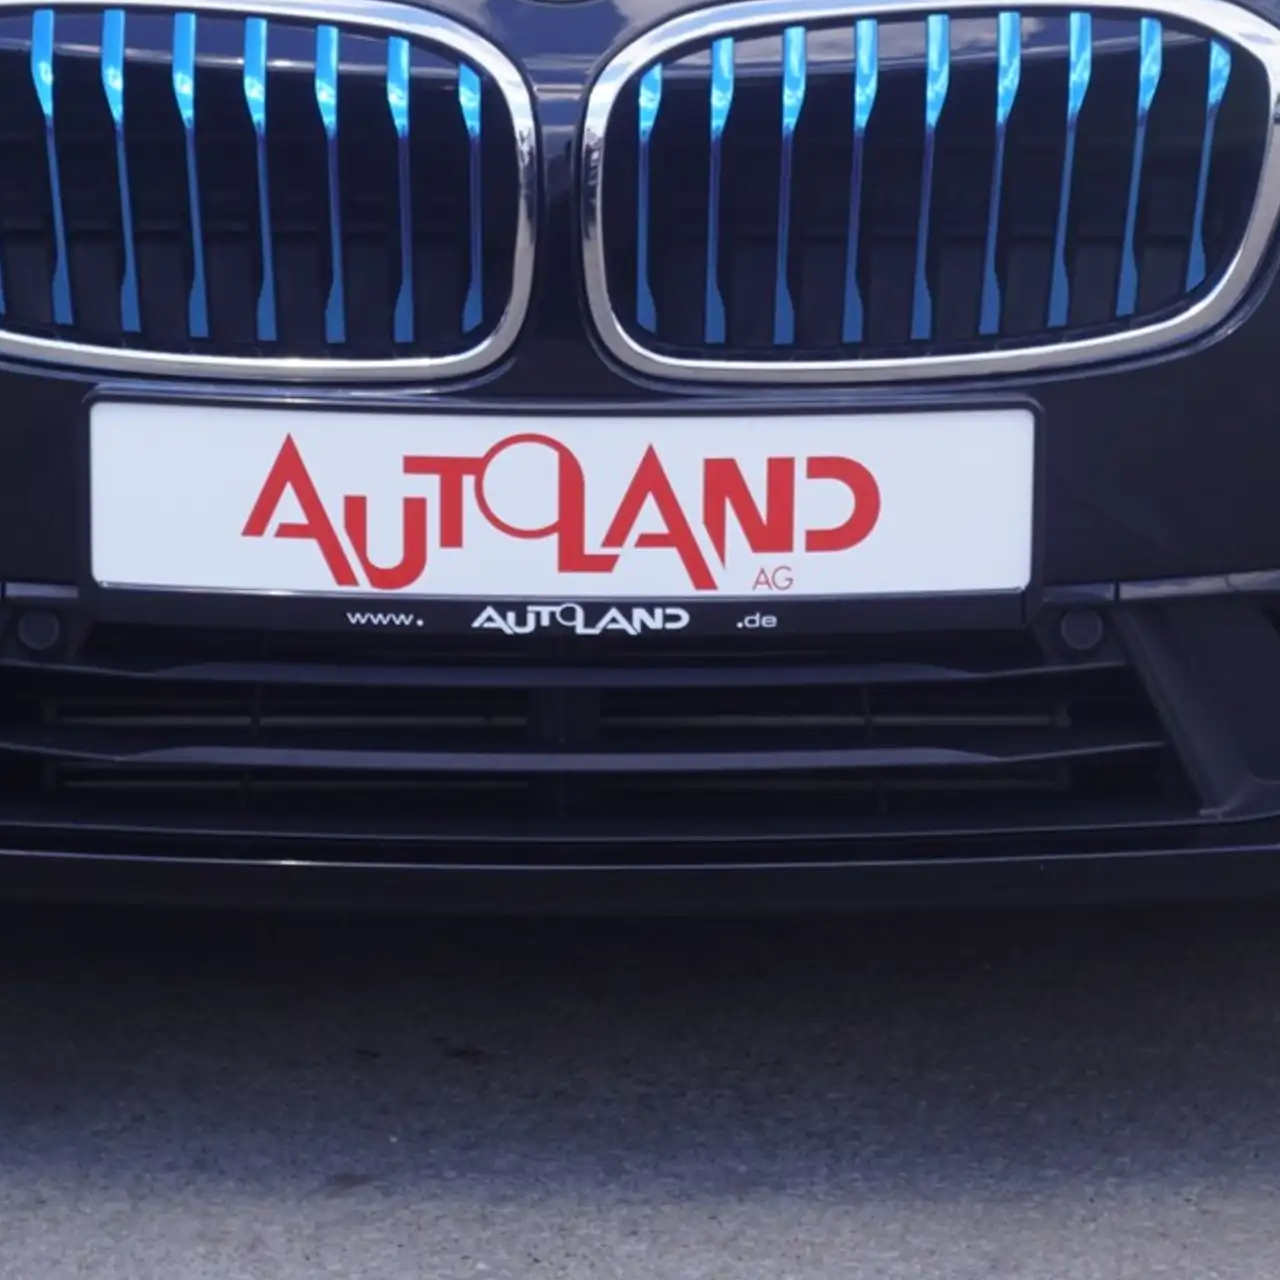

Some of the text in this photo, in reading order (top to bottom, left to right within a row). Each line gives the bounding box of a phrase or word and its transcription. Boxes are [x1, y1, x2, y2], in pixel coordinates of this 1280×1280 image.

[241, 432, 881, 591] AUTOLAND
[753, 565, 795, 592] AG
[346, 602, 778, 636] www. AUTOLAND .de
